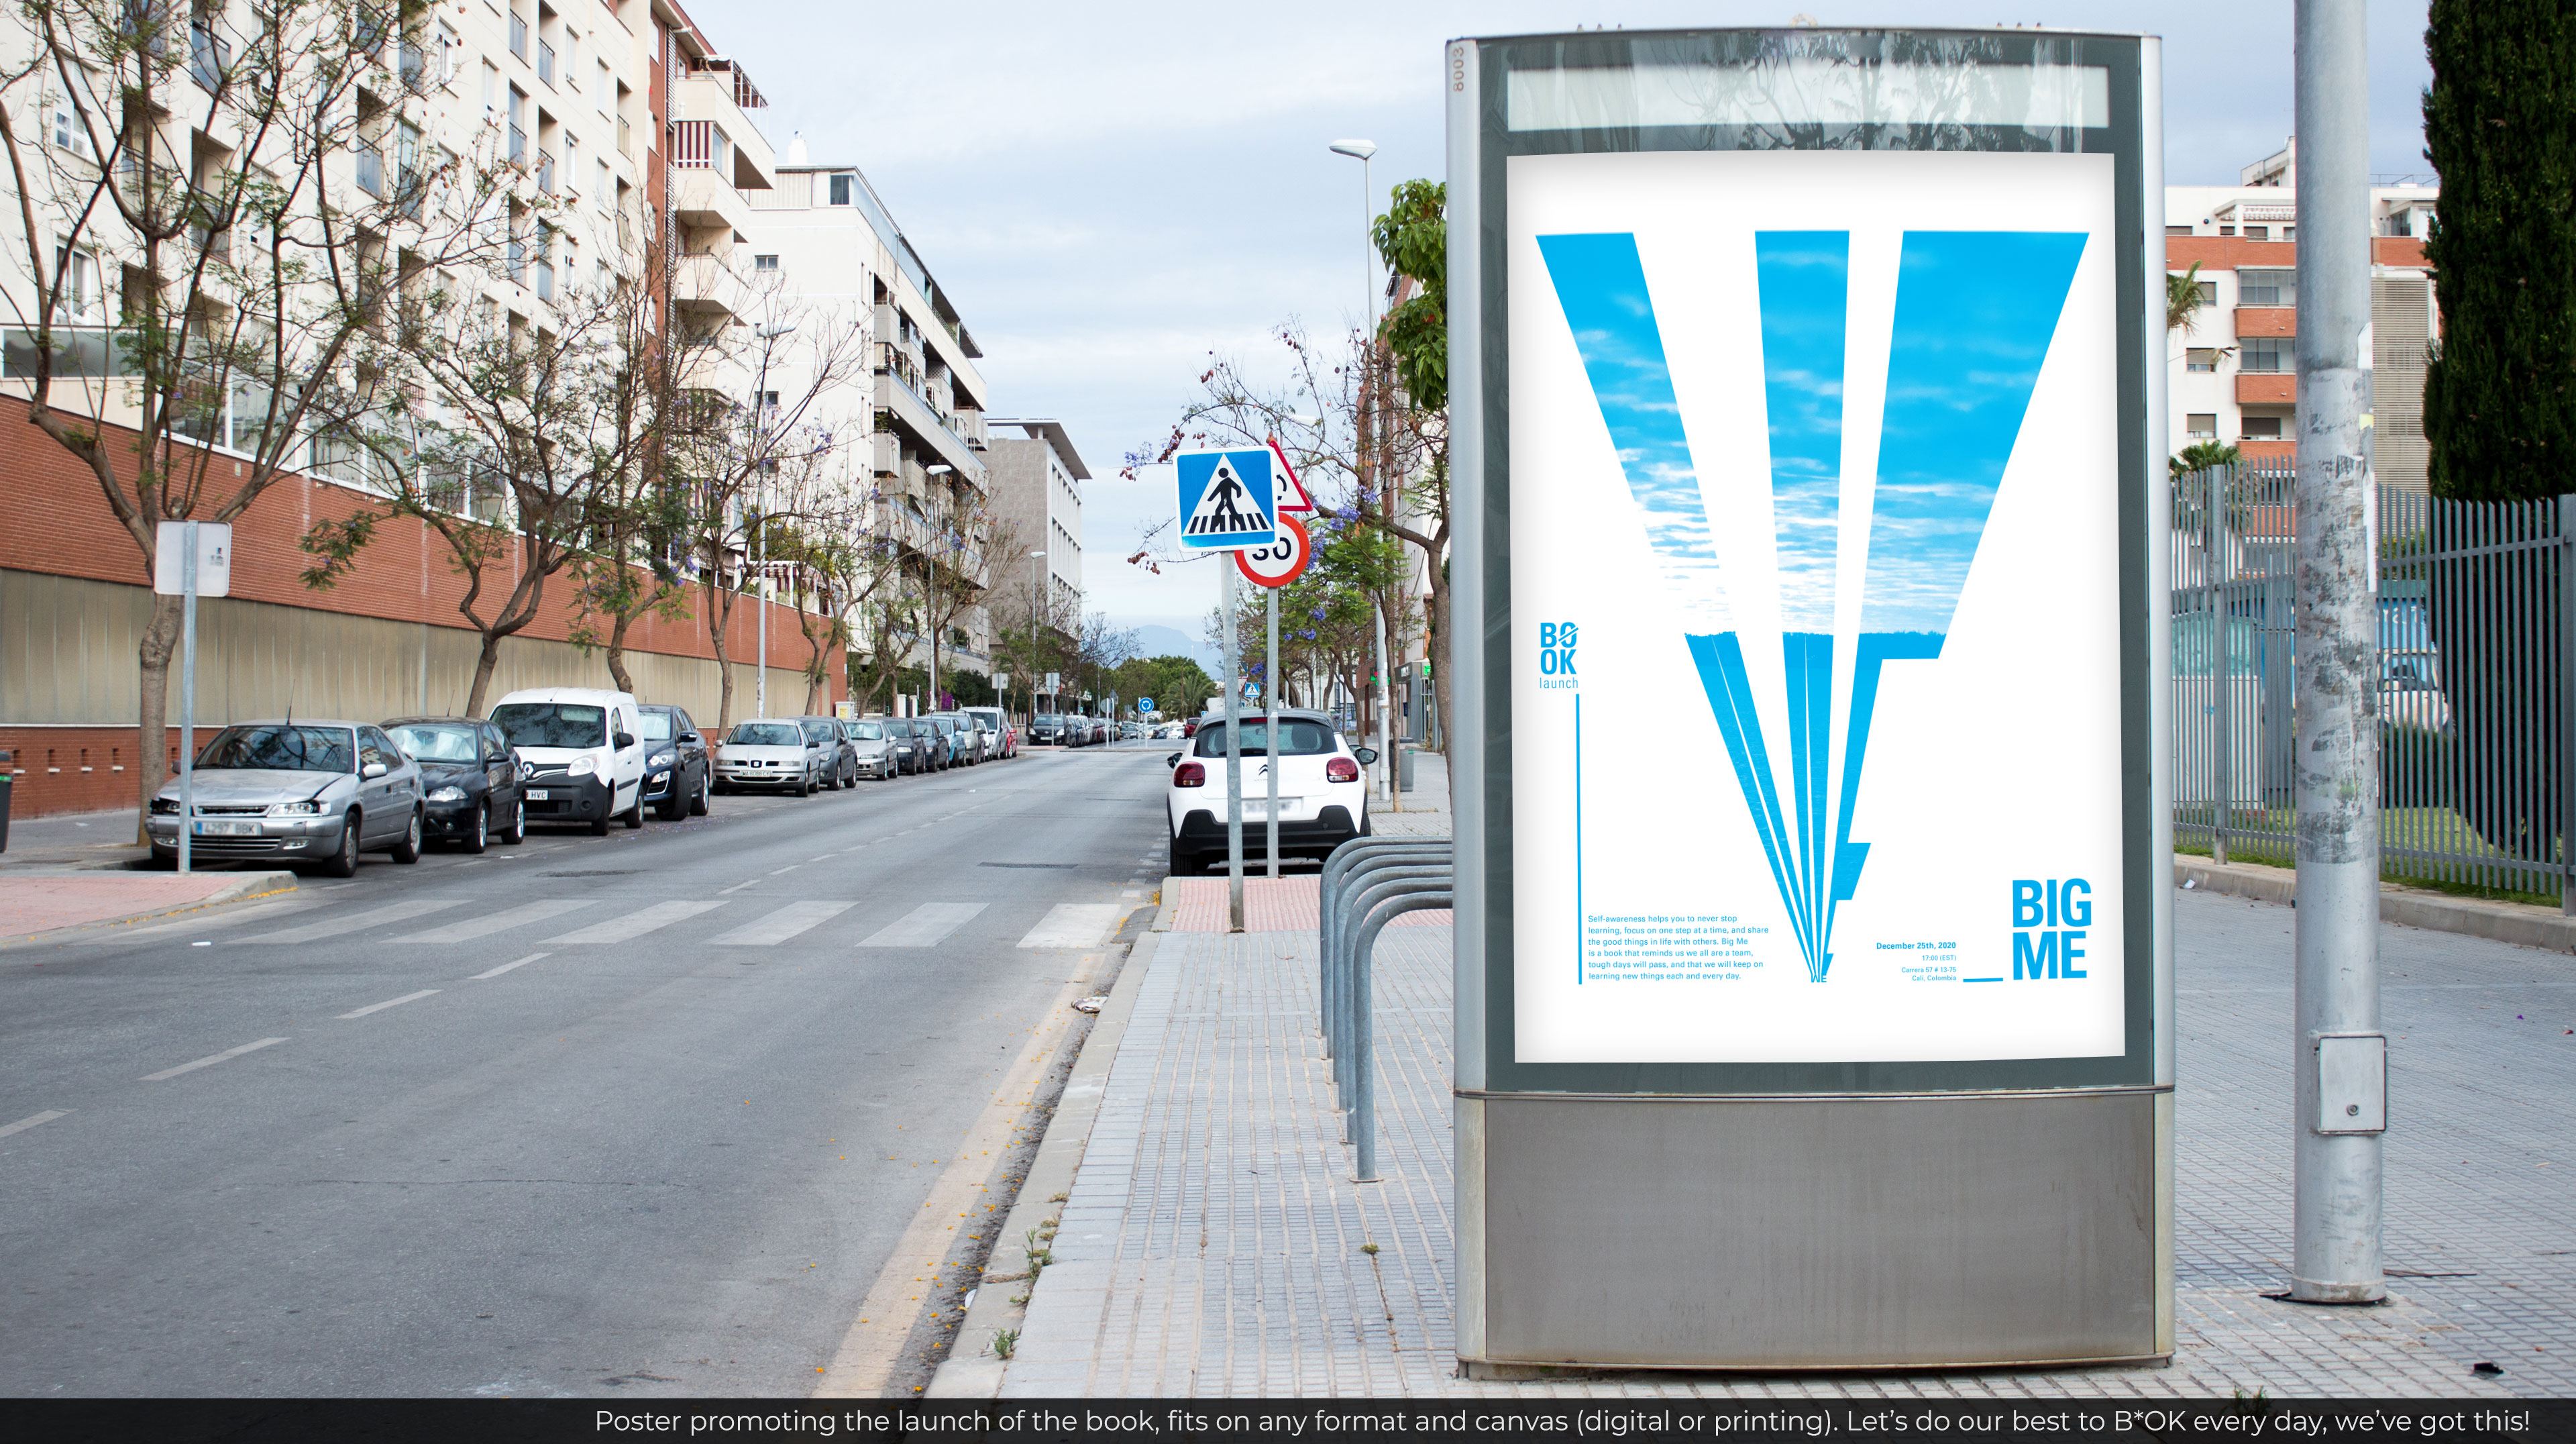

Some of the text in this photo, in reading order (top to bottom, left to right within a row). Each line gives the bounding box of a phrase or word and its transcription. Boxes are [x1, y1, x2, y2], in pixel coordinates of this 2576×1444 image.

[1452, 47, 1464, 92] 8003
[1540, 648, 1577, 675] OK
[1540, 676, 1578, 689] launch
[531, 791, 546, 799] HVC
[2012, 878, 2092, 927] BIG
[1588, 915, 1646, 923] Self-awareness
[1648, 915, 1669, 924] helps
[1670, 916, 1686, 924] you
[1720, 915, 1737, 924] stop
[1588, 926, 1622, 936] learning,
[1623, 926, 1646, 935] focus
[1675, 927, 1692, 936] step
[1709, 926, 1729, 935] time,
[1731, 925, 1746, 934] and
[1747, 925, 1769, 934] share
[1588, 937, 1749, 947] the good things in life with others. Big Me
[1876, 941, 1957, 950] December 25th, 2020
[1588, 949, 1595, 958] is
[1603, 949, 1623, 958] book
[1624, 949, 1640, 958] that
[1642, 949, 1674, 958] reminds
[1699, 949, 1709, 957] all
[1731, 949, 1754, 958] team,
[2012, 930, 2087, 980] ME
[1588, 960, 1611, 970] tough
[1612, 960, 1631, 970] days
[1632, 960, 1647, 968] will
[1648, 962, 1669, 970] pass,
[1670, 960, 1686, 968] and
[1686, 960, 1703, 968] that
[1717, 960, 1731, 968] will
[1733, 960, 1752, 970] keep
[1588, 972, 1620, 982] learning
[1640, 972, 1665, 982] things
[1666, 972, 1684, 980] each
[1685, 972, 1701, 980] and
[1702, 973, 1724, 981] every
[1725, 972, 1741, 981] day.
[1912, 974, 1926, 982] Cali,
